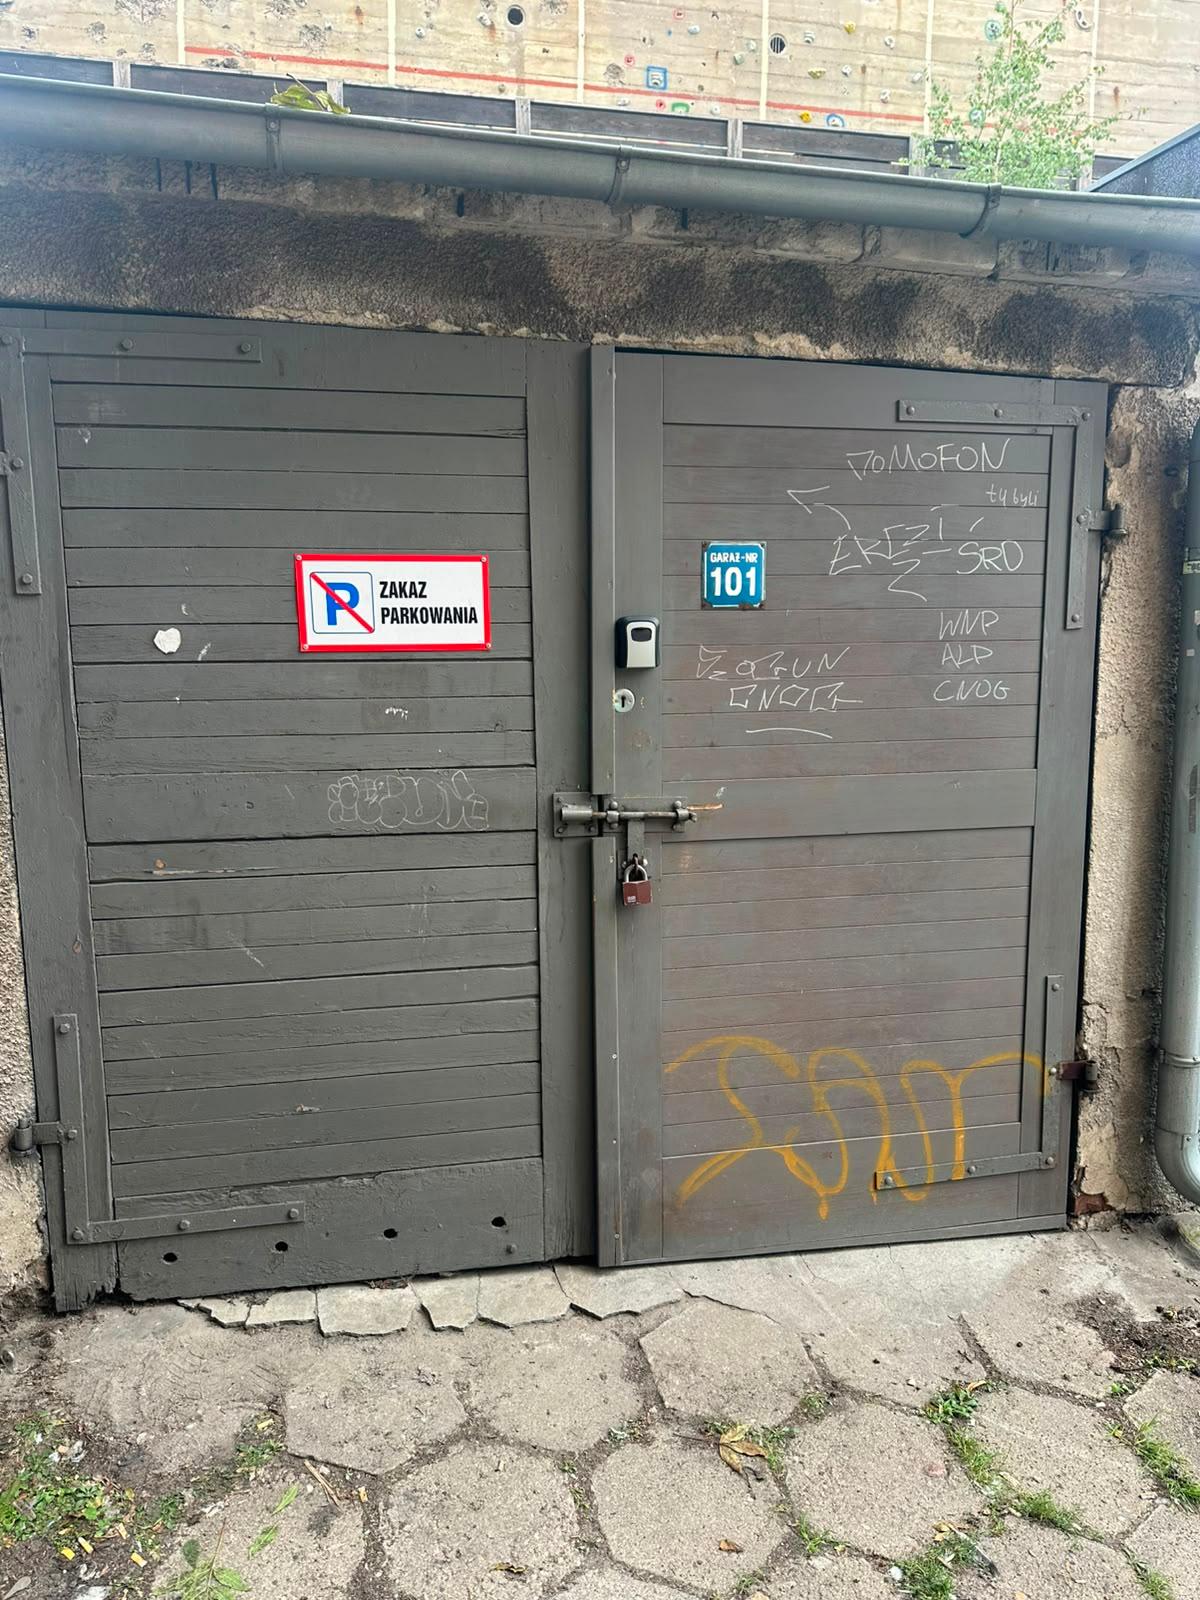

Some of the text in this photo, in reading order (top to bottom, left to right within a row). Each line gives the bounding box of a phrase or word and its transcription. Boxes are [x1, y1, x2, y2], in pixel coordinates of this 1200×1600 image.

[846, 438, 1011, 481] DOMOFON
[379, 581, 428, 599] ZAKAZ
[710, 566, 757, 597] 101
[380, 606, 478, 625] PARKOWANIA
